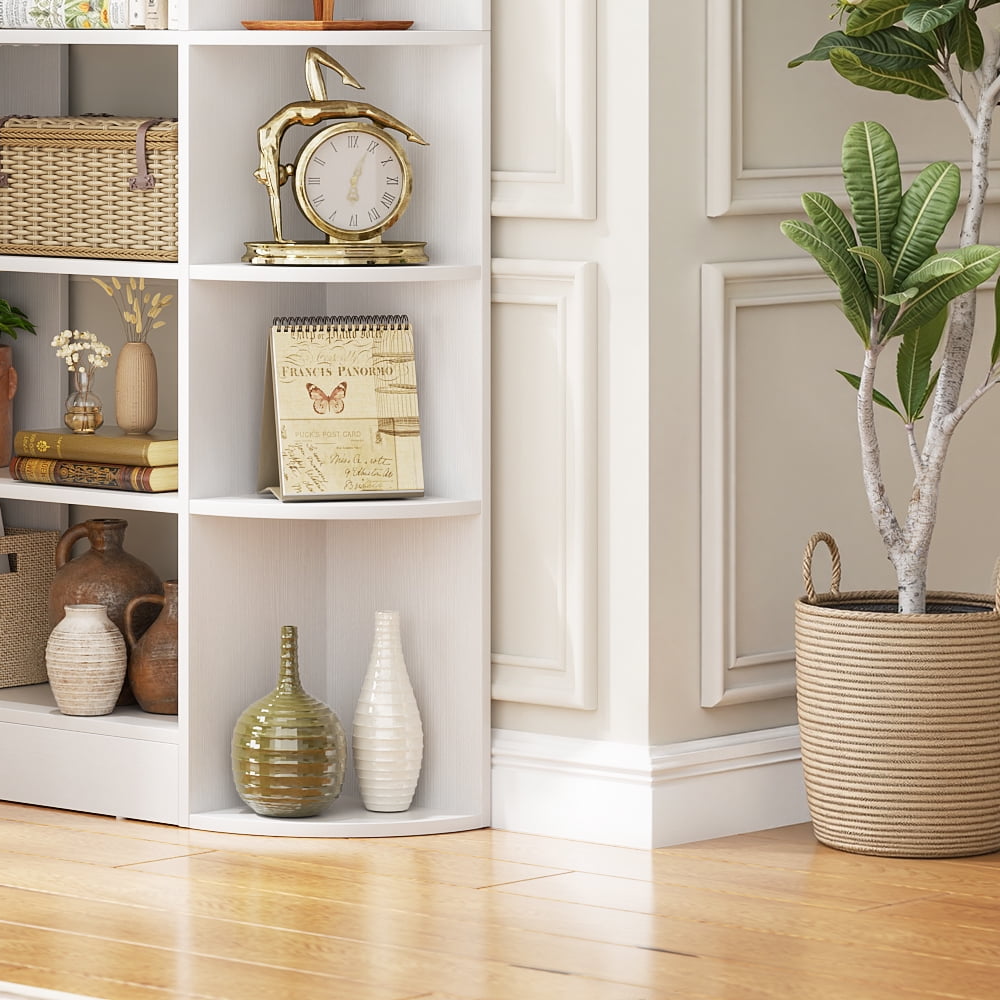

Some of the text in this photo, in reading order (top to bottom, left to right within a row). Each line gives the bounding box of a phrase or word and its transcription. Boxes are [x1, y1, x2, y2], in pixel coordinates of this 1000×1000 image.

[282, 366, 394, 377] FRANCIS PANORMO
[343, 430, 362, 438] CARD
